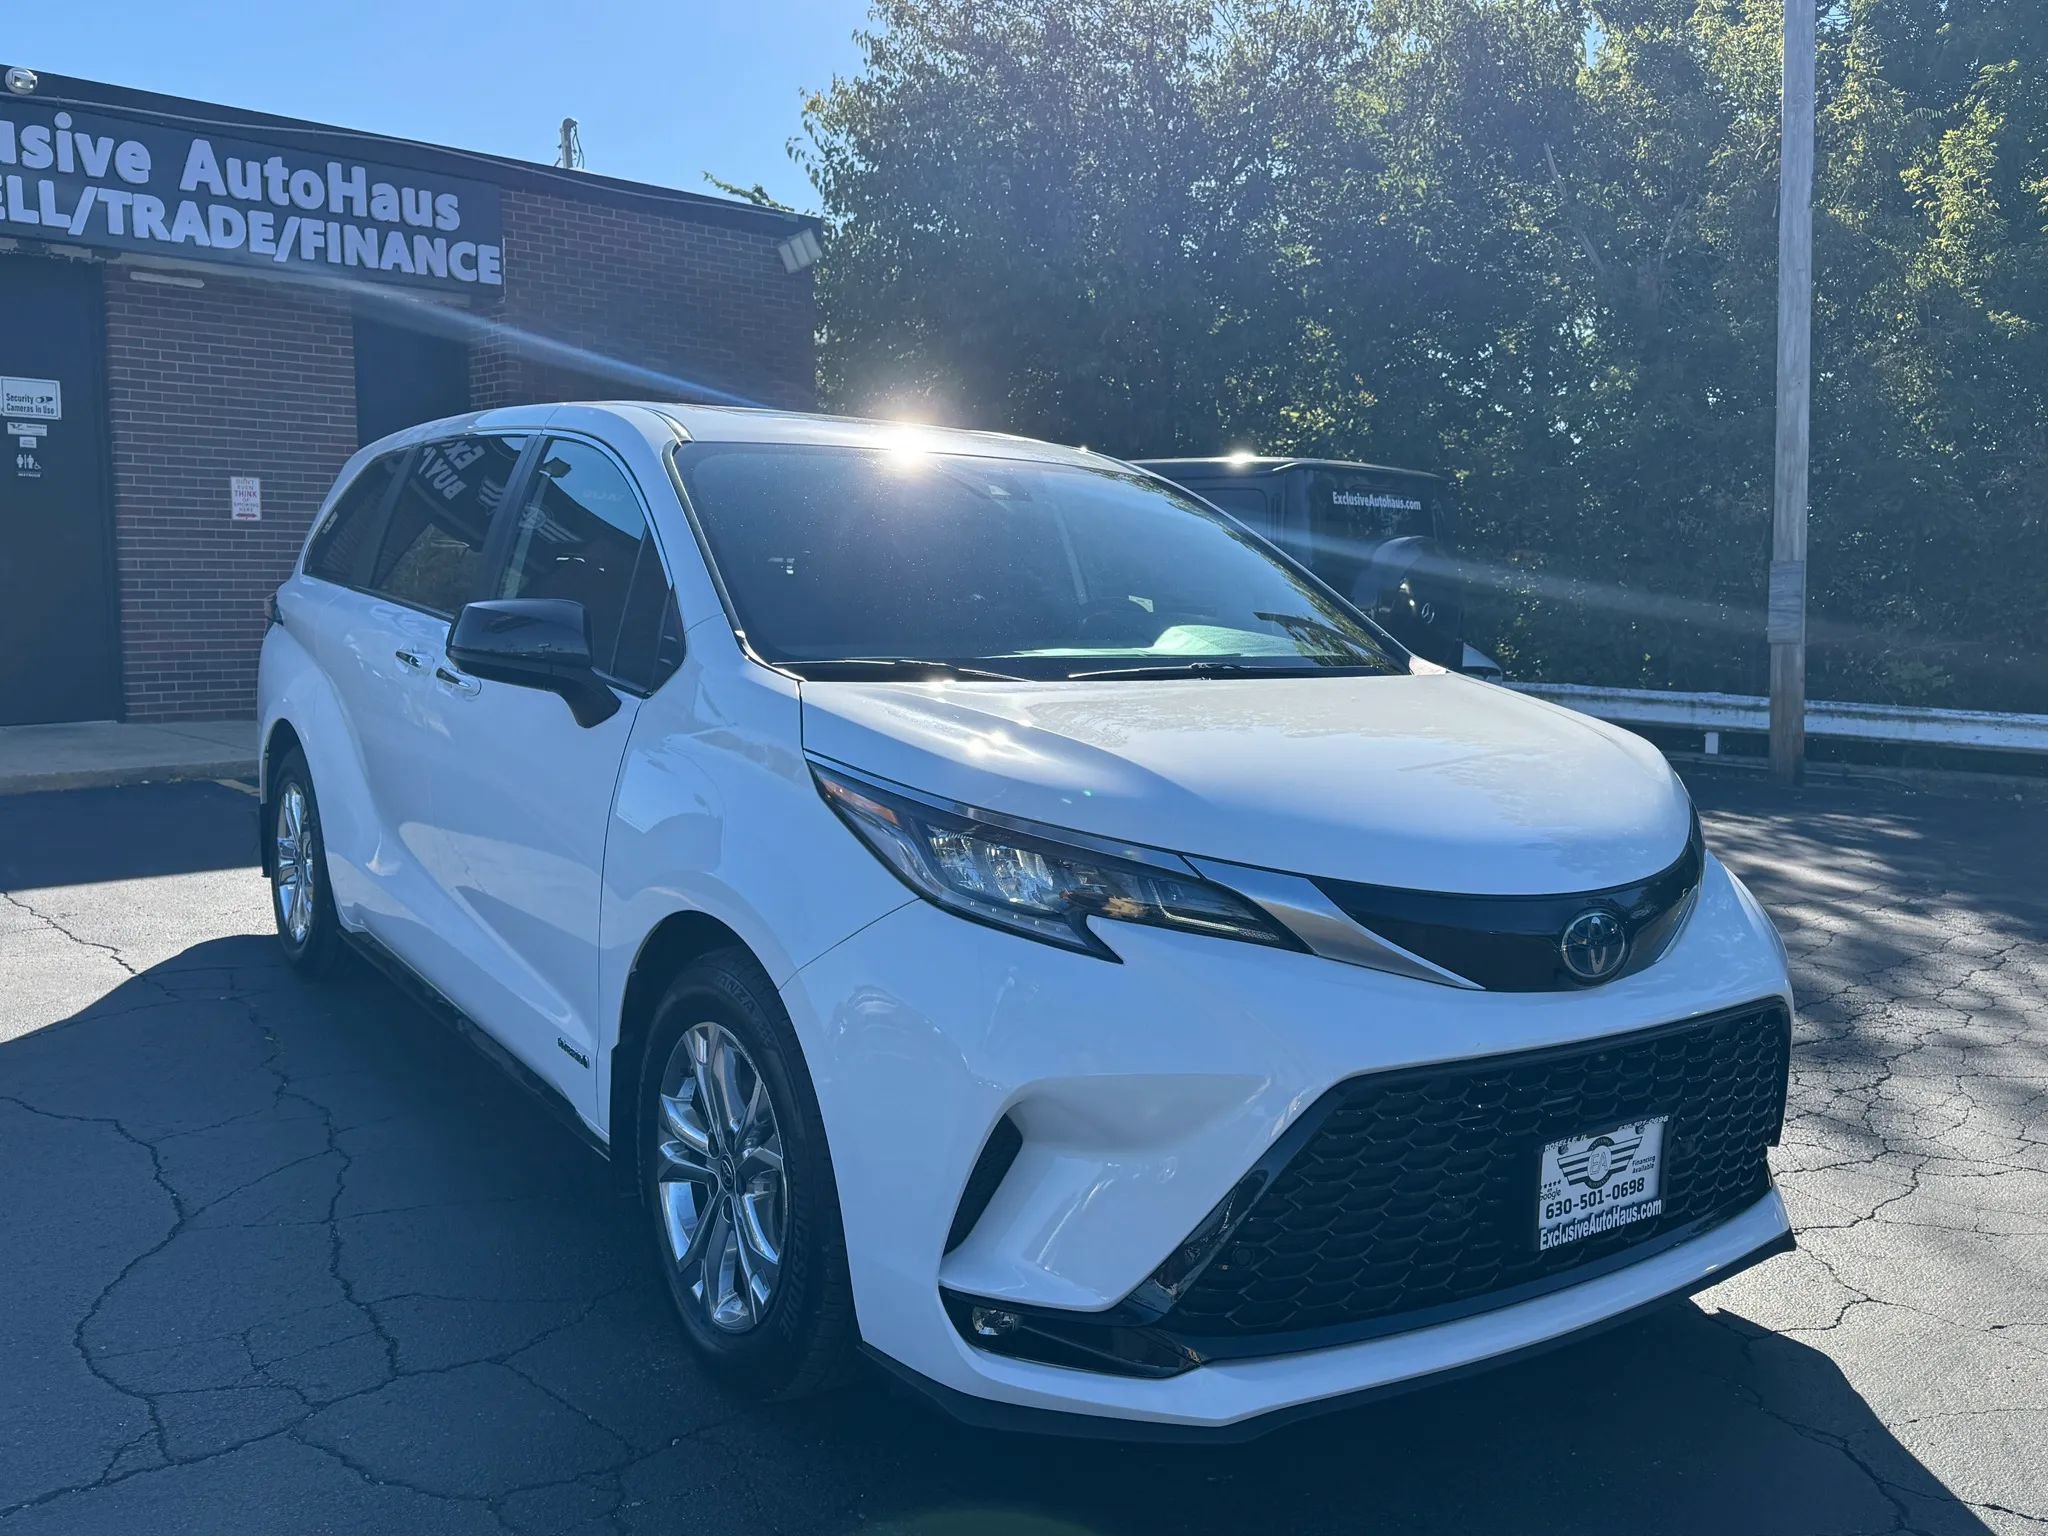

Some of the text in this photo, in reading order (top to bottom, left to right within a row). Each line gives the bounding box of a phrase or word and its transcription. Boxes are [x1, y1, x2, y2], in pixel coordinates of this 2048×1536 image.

[180, 138, 460, 231] AutoHaus
[0, 175, 503, 286] LL/TRADE/FINANCE
[6, 393, 34, 404] Security
[7, 403, 33, 413] Cameras
[43, 405, 55, 415] Use
[234, 490, 257, 498] THINK
[1332, 491, 1421, 510] ExclusiveAutohaus.com
[1632, 1156, 1656, 1167] Financing
[1632, 1163, 1655, 1174] Available
[1546, 1177, 1645, 1219] 630-501-0698
[1540, 1199, 1662, 1251] ExclusiveAutoHaus.com
